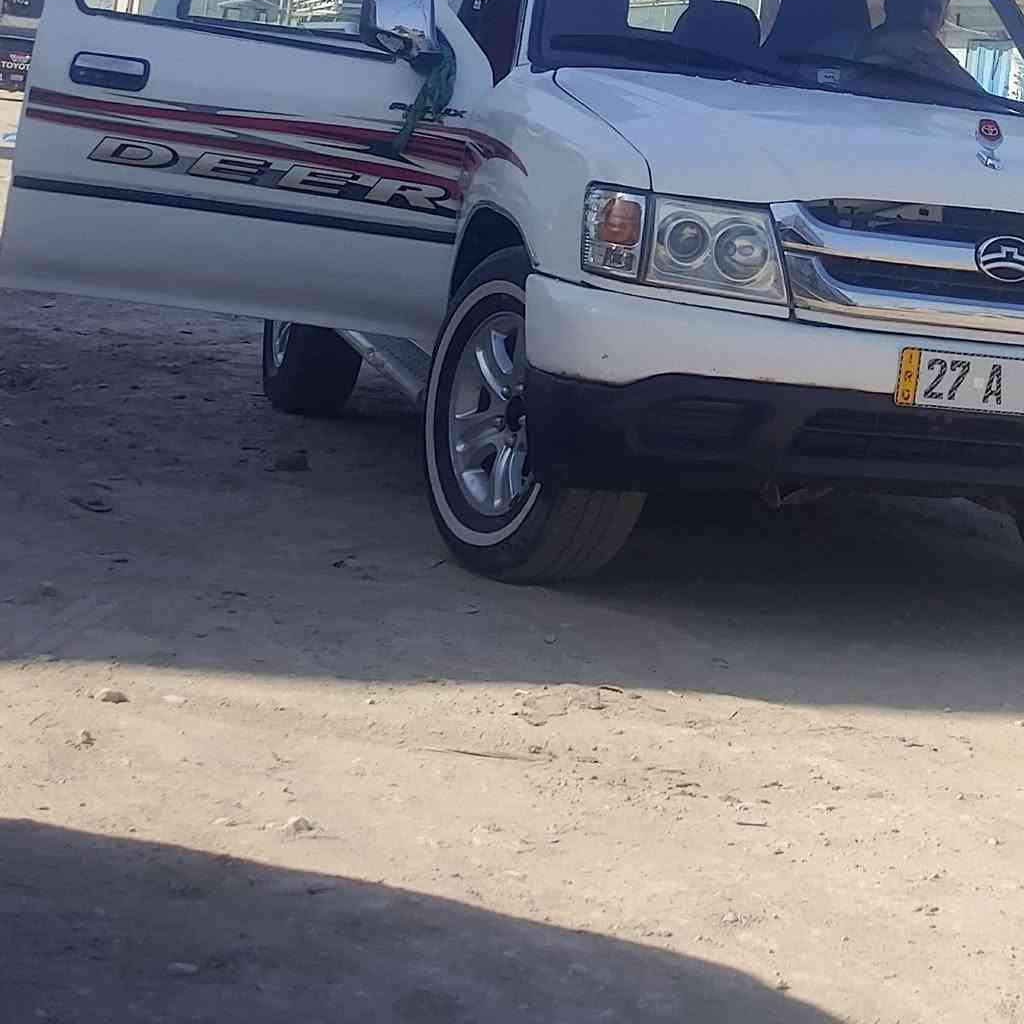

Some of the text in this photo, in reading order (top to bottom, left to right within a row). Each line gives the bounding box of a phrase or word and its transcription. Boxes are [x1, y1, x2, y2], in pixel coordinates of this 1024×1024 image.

[1, 60, 31, 72] TOYOT
[87, 135, 456, 218] DEER
[923, 358, 970, 401] 27
[982, 364, 1002, 405] A
